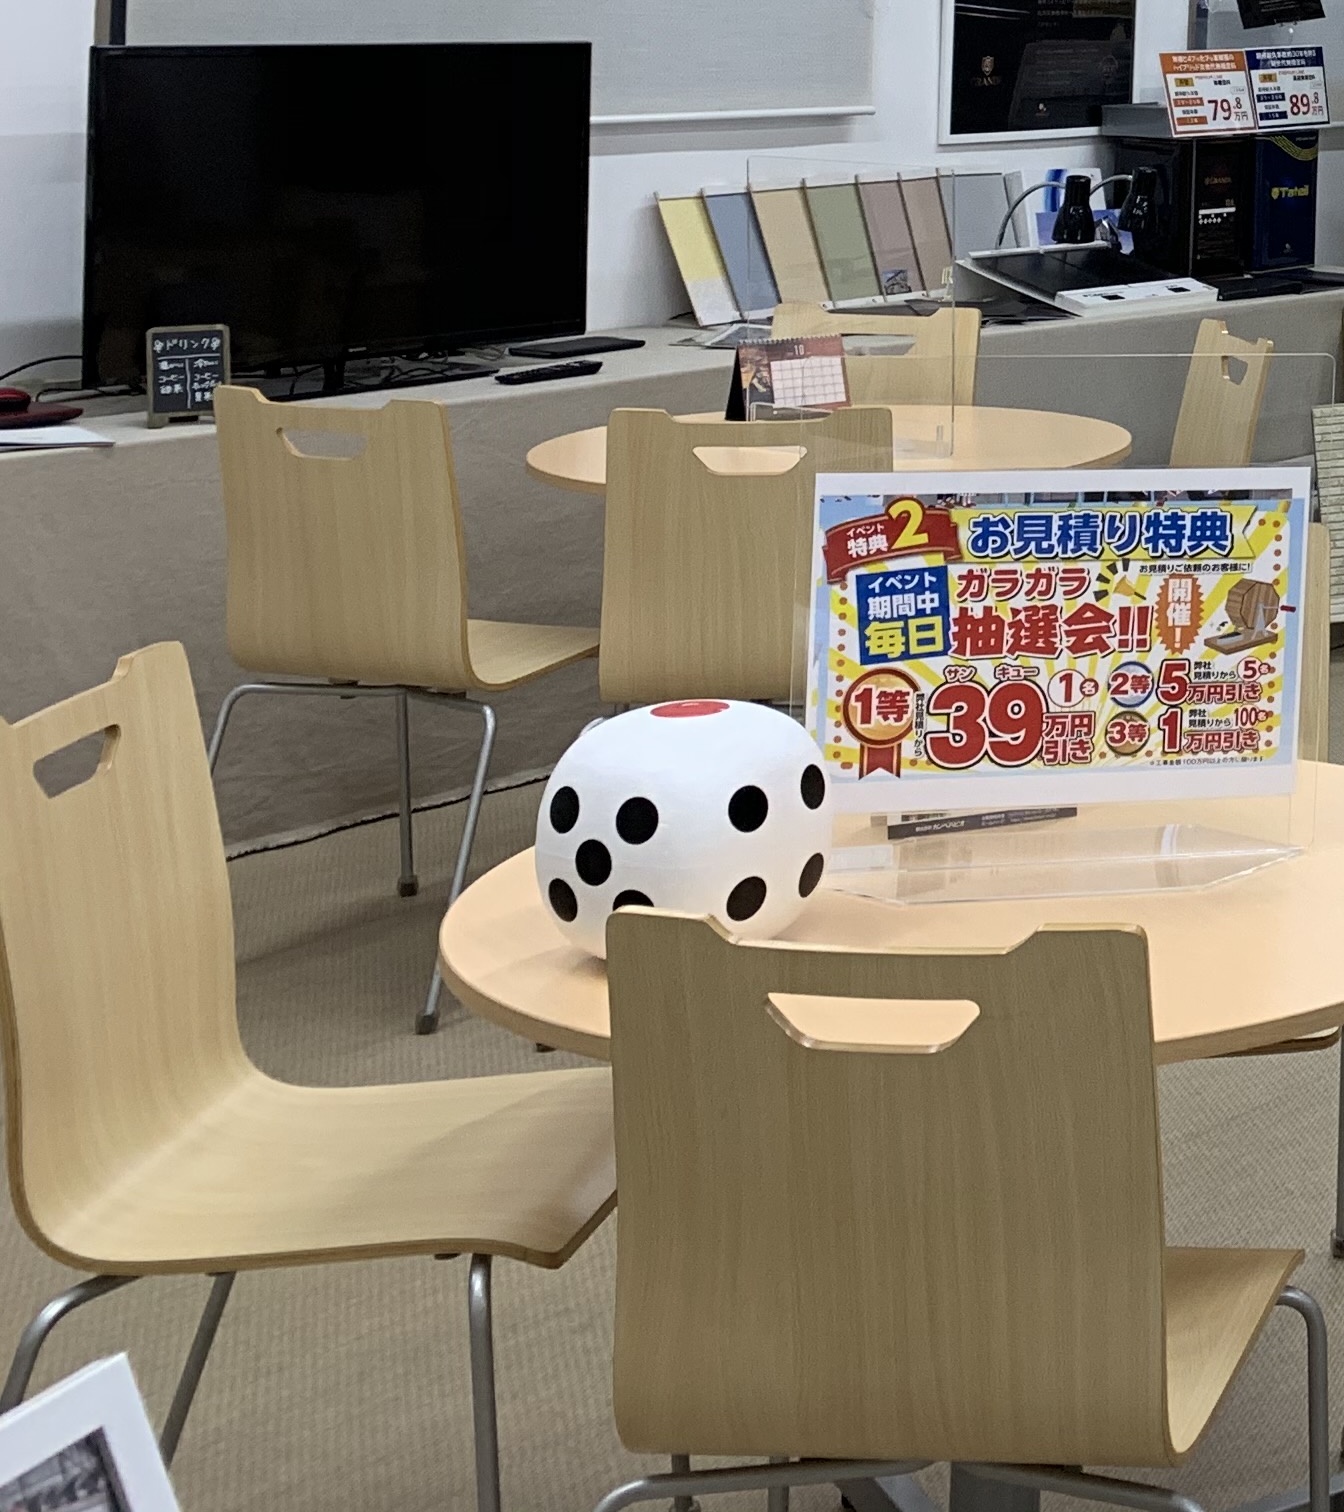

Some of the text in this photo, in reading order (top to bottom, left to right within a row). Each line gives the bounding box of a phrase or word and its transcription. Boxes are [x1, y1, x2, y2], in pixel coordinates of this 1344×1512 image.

[846, 499, 929, 559] 特典 2
[846, 522, 885, 537] イベント
[970, 510, 1231, 557] お見積り特典
[867, 571, 938, 594] イベント
[955, 565, 1090, 601] ガラガラ
[866, 590, 940, 621] 期間中
[864, 615, 944, 659] 毎日
[949, 602, 1151, 659] 抽選会!!
[944, 664, 1039, 683] サン キュー
[853, 686, 911, 727] 1等
[928, 681, 1045, 766] 39
